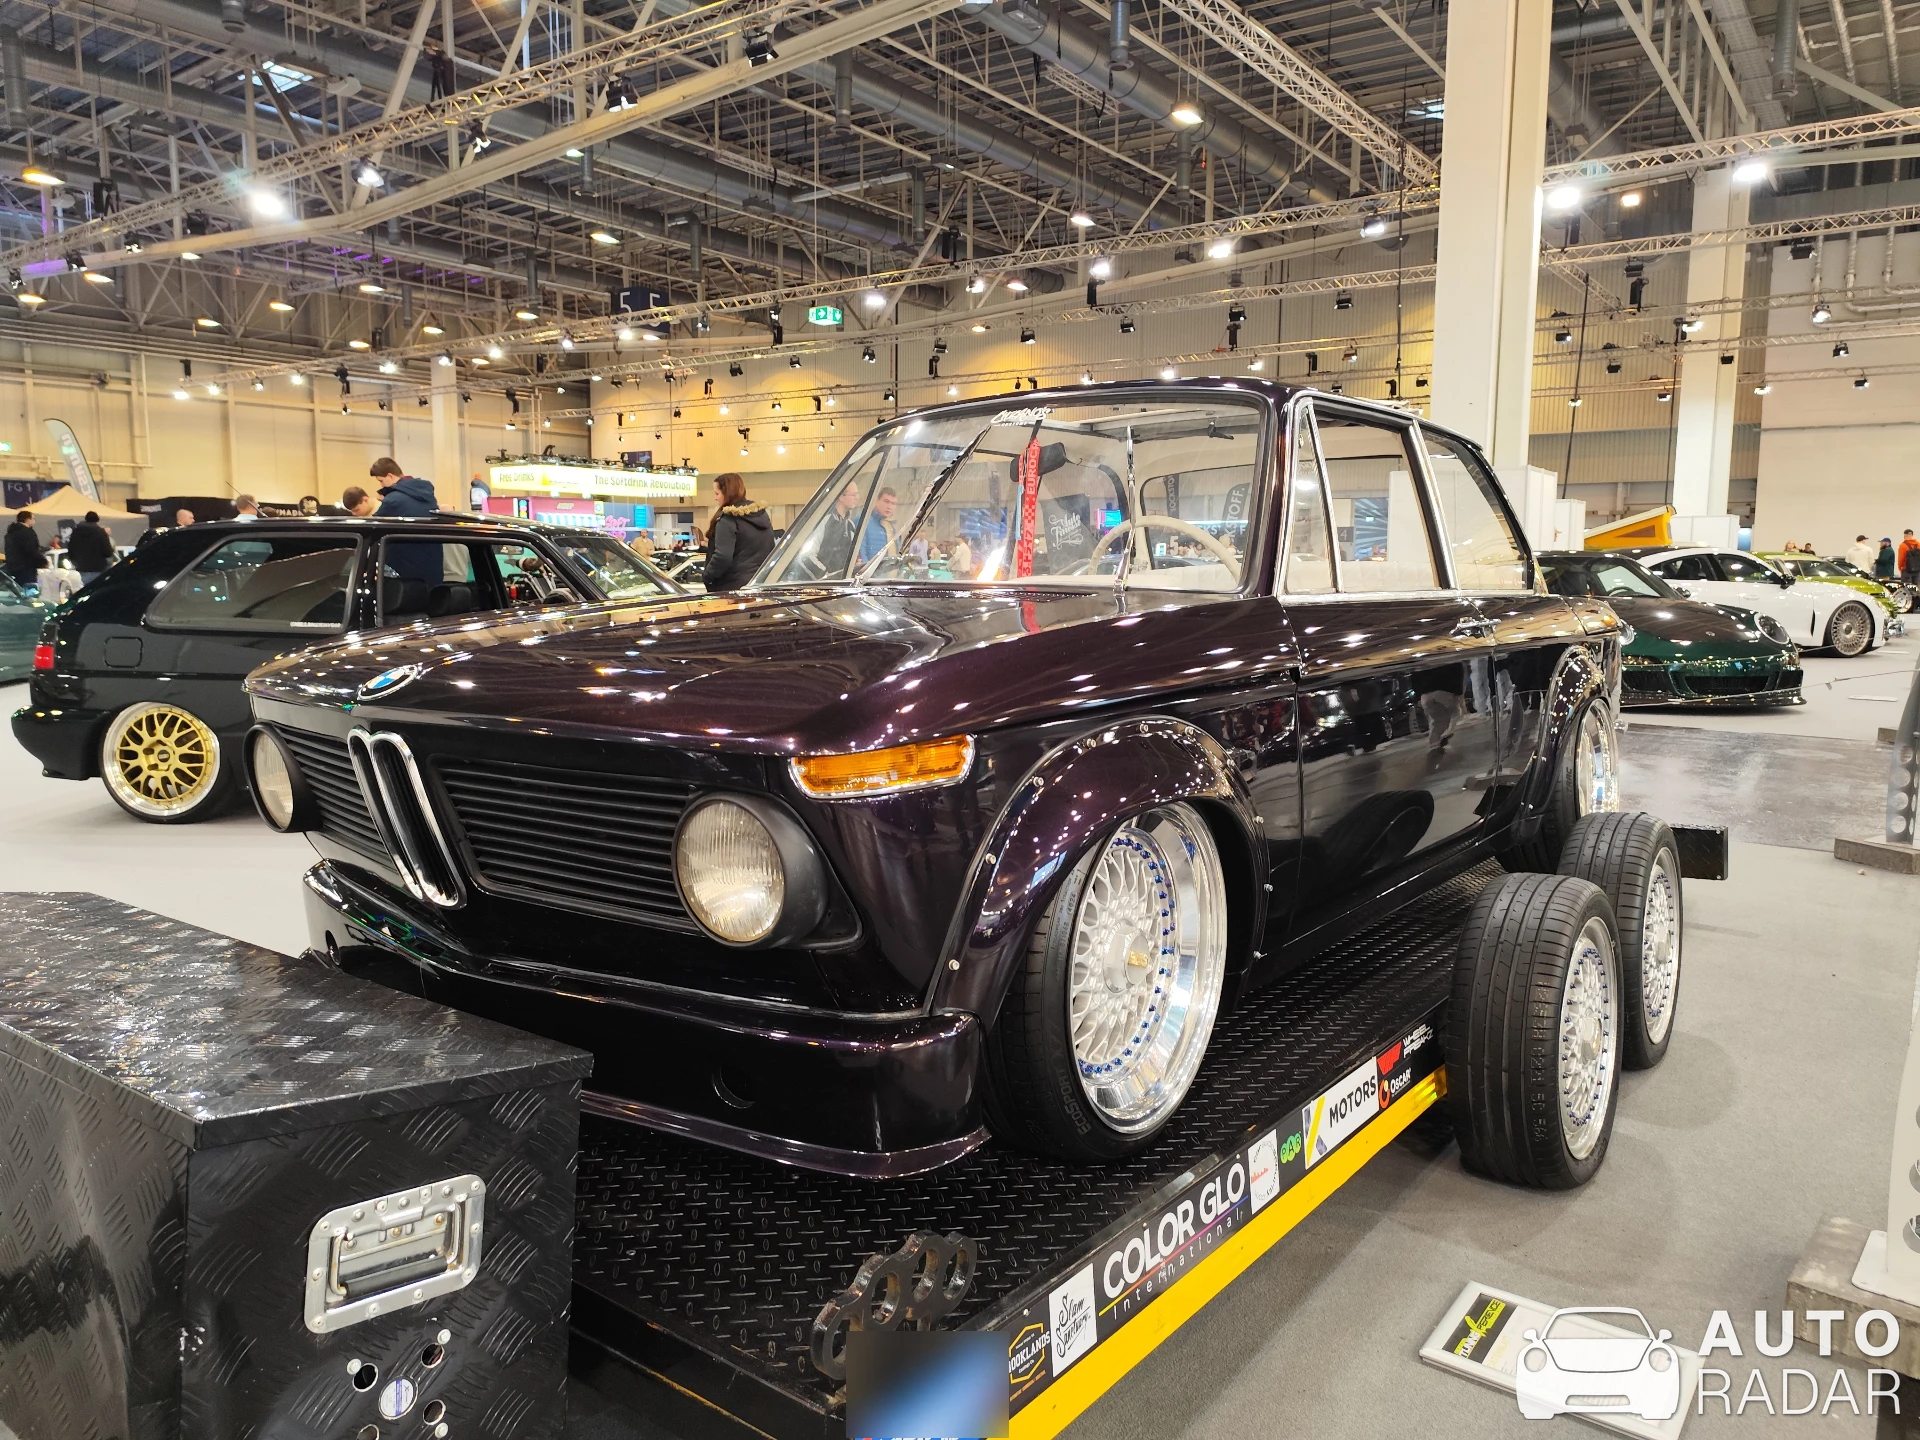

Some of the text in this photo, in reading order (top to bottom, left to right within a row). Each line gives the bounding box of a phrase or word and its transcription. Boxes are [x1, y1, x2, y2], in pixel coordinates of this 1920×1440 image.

[7, 483, 23, 493] FG
[594, 474, 691, 491] The Softdrink Revolution
[1390, 1067, 1411, 1090] OSCAR
[1329, 1075, 1377, 1129] MOTORS
[1103, 1199, 1195, 1299] COLOR
[1199, 1162, 1246, 1225] GLO
[1112, 1207, 1239, 1320] International
[1009, 1330, 1051, 1373] OOKLANDS
